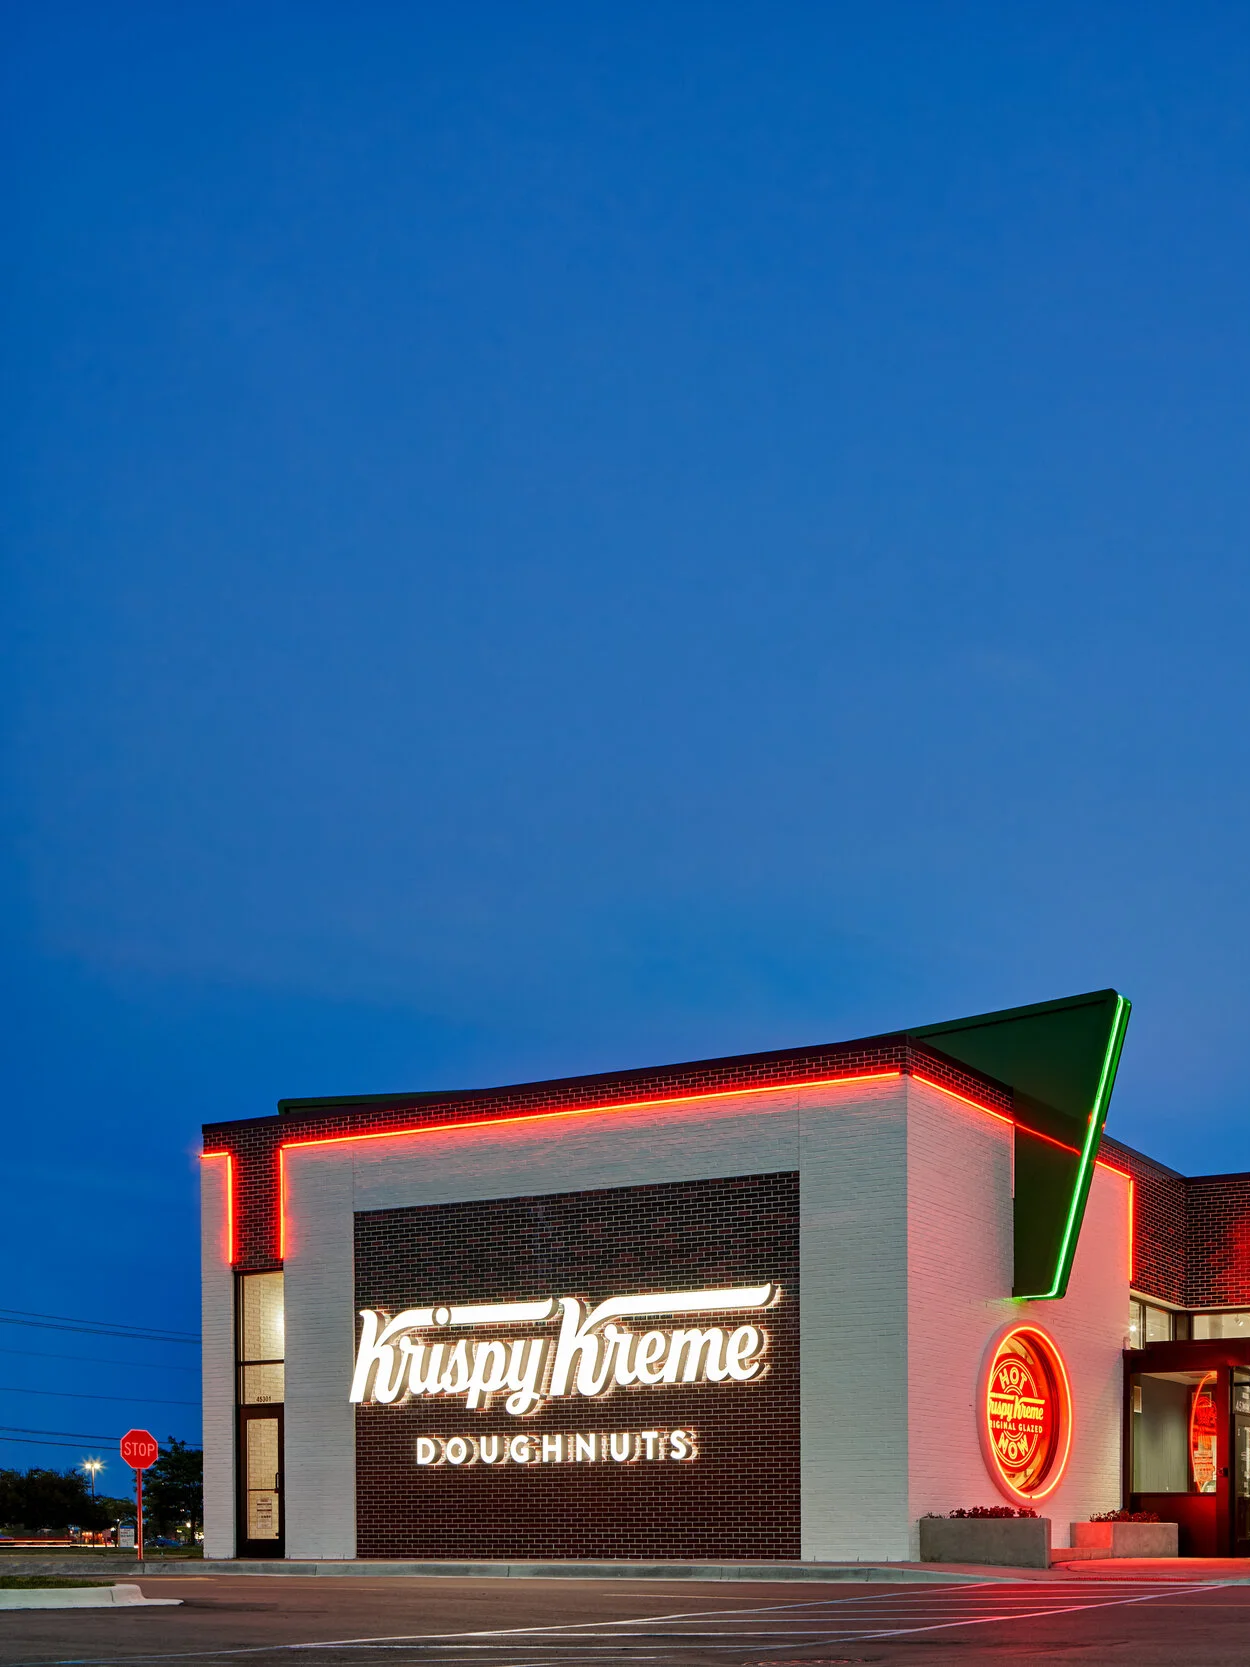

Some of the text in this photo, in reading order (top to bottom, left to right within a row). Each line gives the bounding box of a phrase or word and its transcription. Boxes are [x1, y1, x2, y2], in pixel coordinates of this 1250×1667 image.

[350, 1283, 778, 1416] Krispy Kreme
[999, 1366, 1028, 1390] HOT
[989, 1392, 1045, 1422] rispy Kreme
[989, 1420, 1043, 1434] RIGINAL GLAZED
[124, 1441, 155, 1457] STOP
[416, 1430, 697, 1465] DOUGHNUTS
[998, 1432, 1029, 1460] NOW
